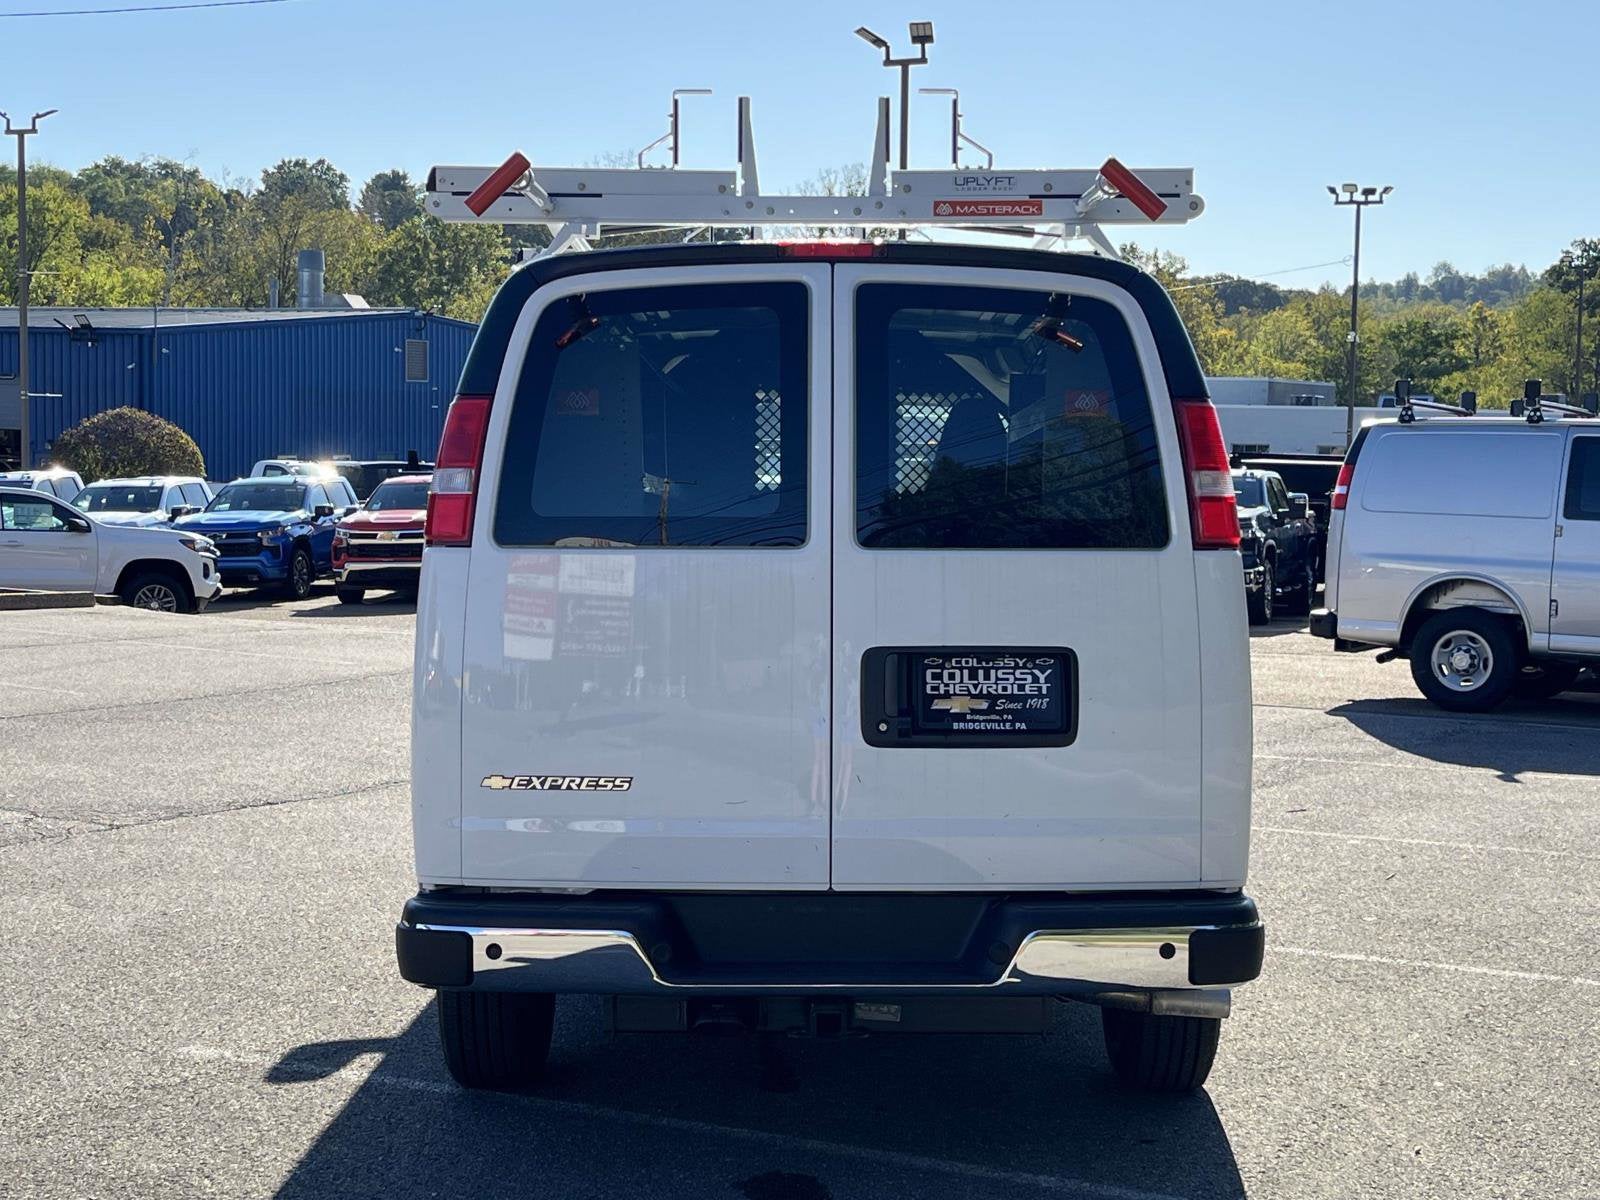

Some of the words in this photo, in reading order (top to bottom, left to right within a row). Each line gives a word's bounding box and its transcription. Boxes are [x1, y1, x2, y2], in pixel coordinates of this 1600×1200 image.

[954, 176, 1015, 186] UPLYFT
[956, 205, 1039, 214] MASTERACK
[951, 658, 1027, 667] COLUSSY
[926, 669, 1053, 684] COLUSSY
[926, 684, 1051, 695] CHEVROLET
[995, 699, 1023, 710] Since
[1026, 698, 1050, 710] 1918
[1015, 722, 1028, 730] PA
[510, 776, 632, 791] EXPRESS
